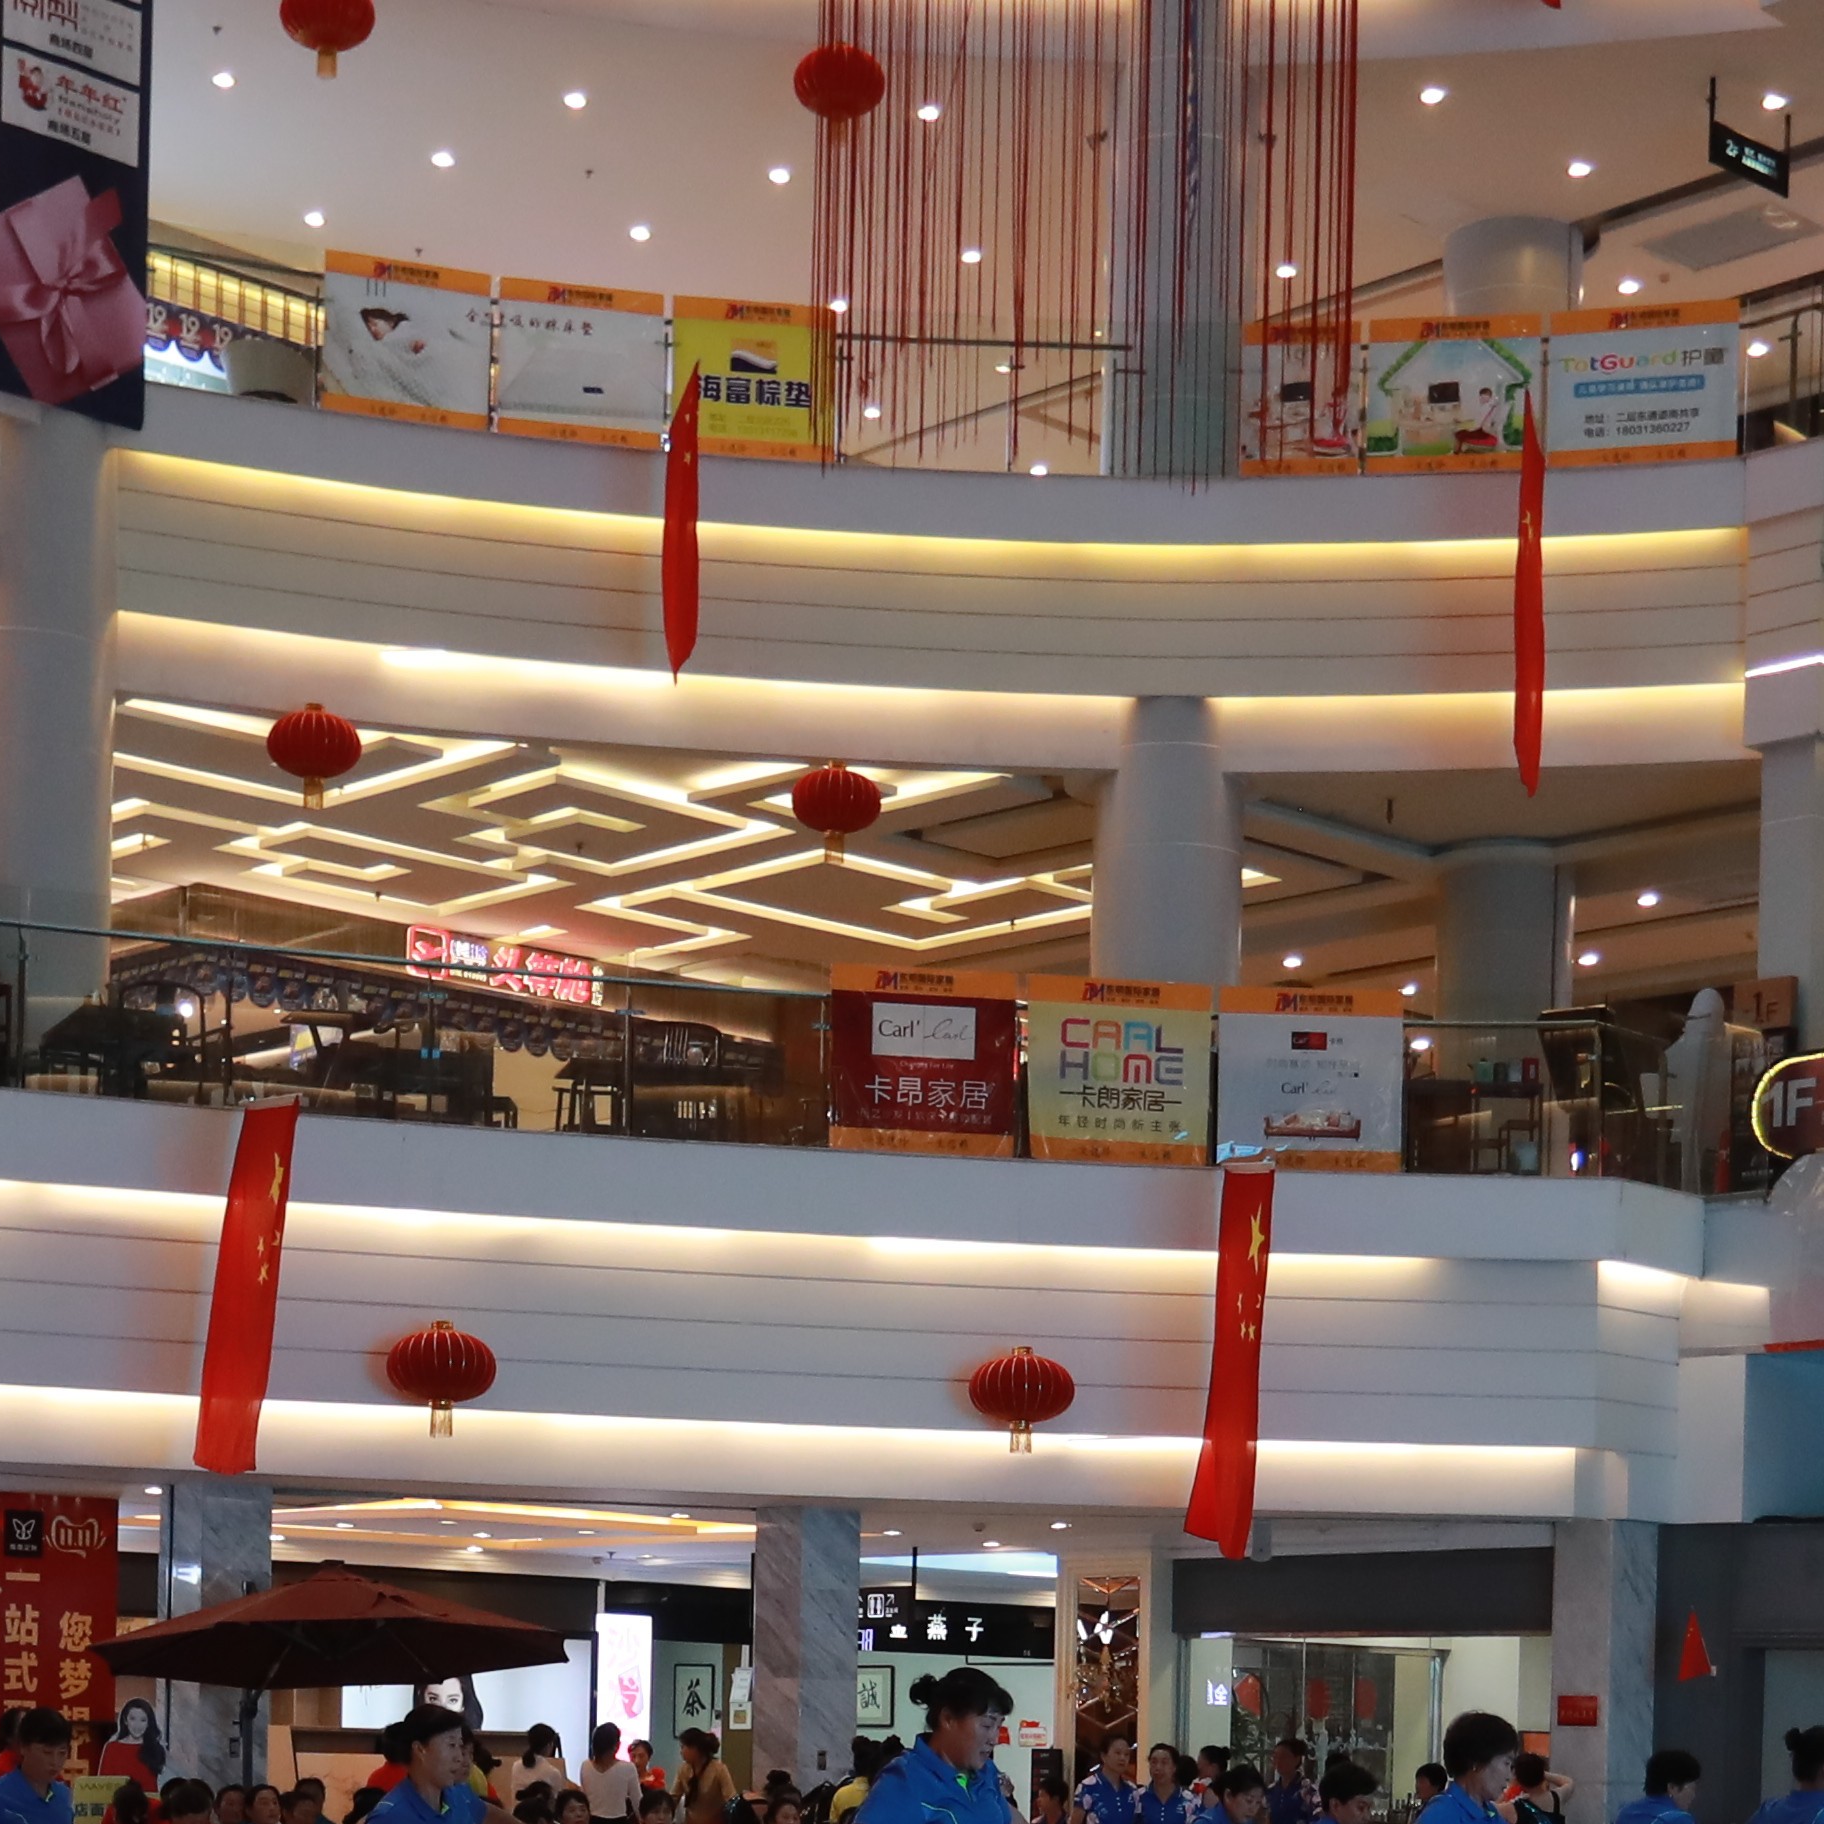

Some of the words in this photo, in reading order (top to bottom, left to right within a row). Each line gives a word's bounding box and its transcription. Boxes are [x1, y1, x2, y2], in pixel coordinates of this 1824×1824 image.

[1059, 1049, 1184, 1087] HOME
[865, 1074, 989, 1111] 卡昂家居
[1059, 1084, 1182, 1113] 卡朗家居
[1058, 1114, 1183, 1134] 年轻时尚新主张
